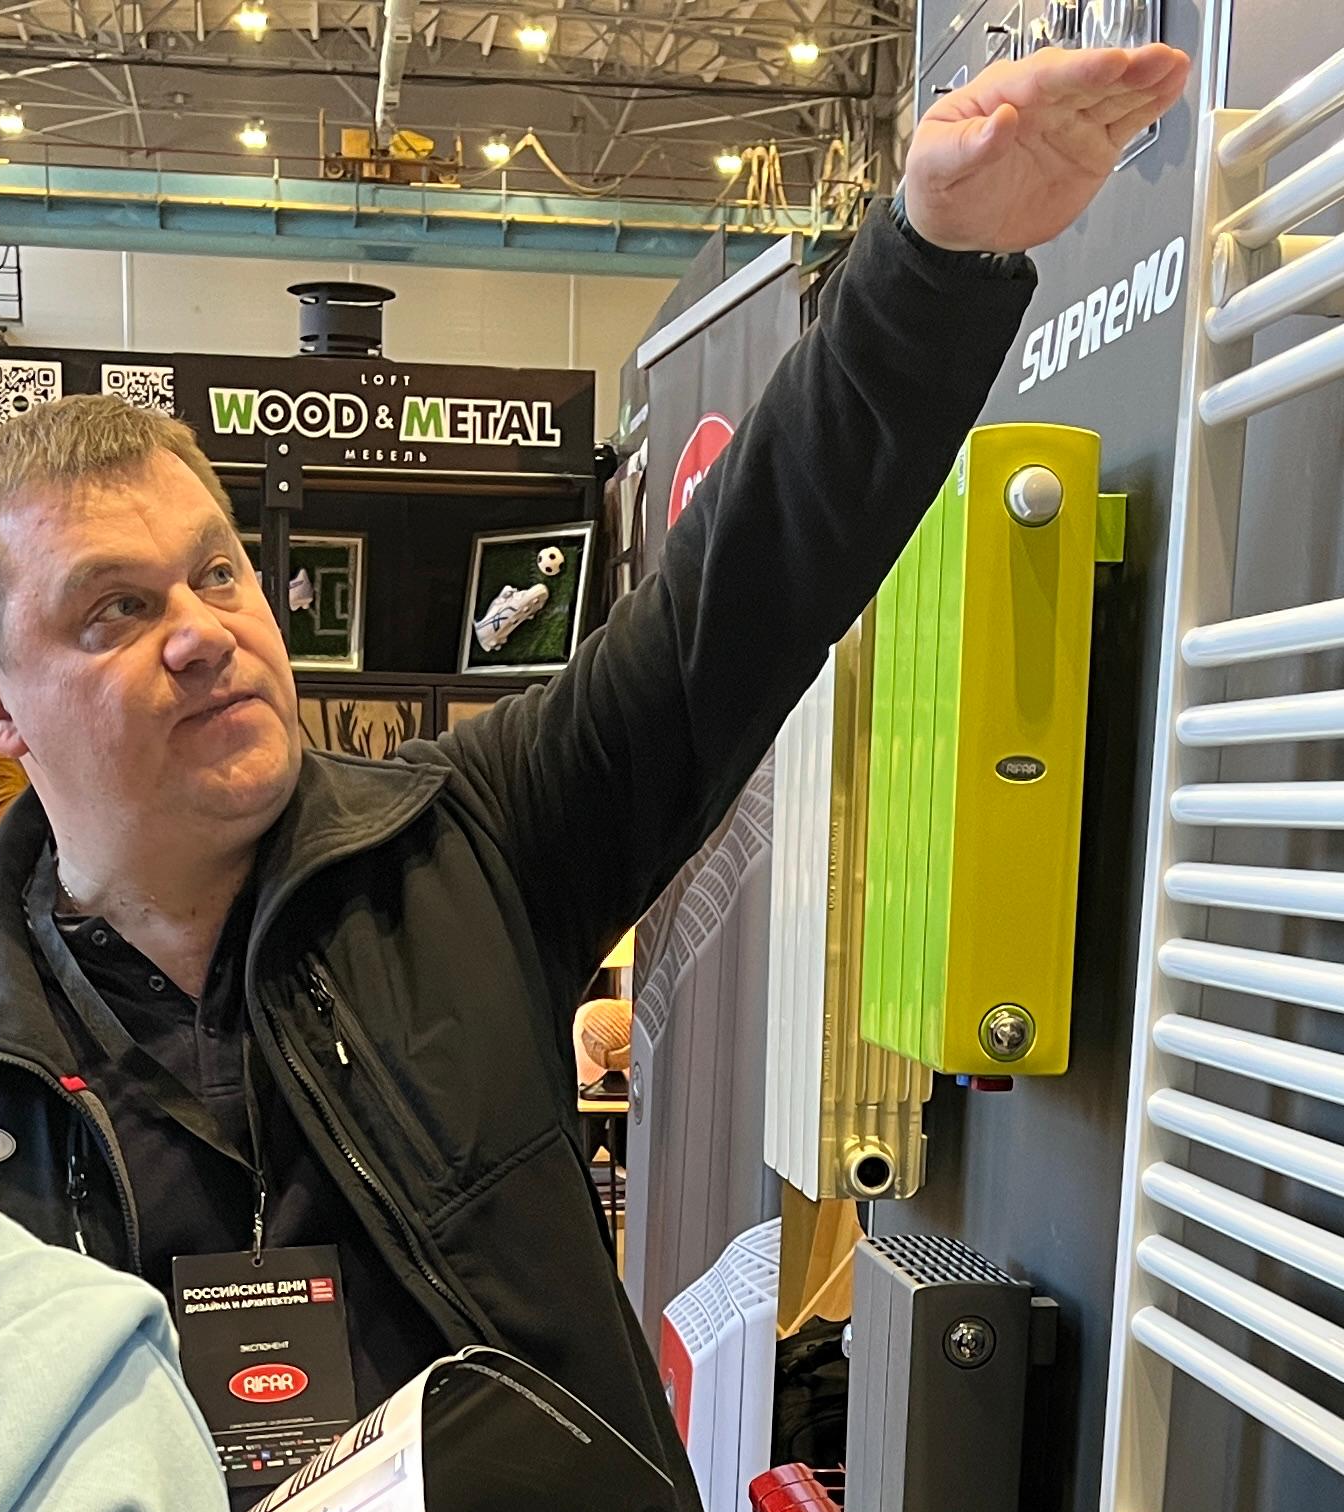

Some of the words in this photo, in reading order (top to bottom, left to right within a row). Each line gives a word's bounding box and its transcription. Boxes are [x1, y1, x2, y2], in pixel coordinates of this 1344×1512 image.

[360, 373, 411, 387] LOFT
[208, 387, 368, 438] WOOD
[374, 404, 395, 430] &
[399, 396, 561, 447] METAL
[344, 448, 428, 463] МЕБЕЛЬ
[183, 1282, 275, 1301] РОССИЙСКИЕ
[277, 1279, 307, 1295] ДНИ
[185, 1300, 232, 1315] ДИЗАЙНА
[241, 1294, 309, 1309] АРХИТЕКТУРЫ
[243, 1373, 294, 1394] RIFAR
